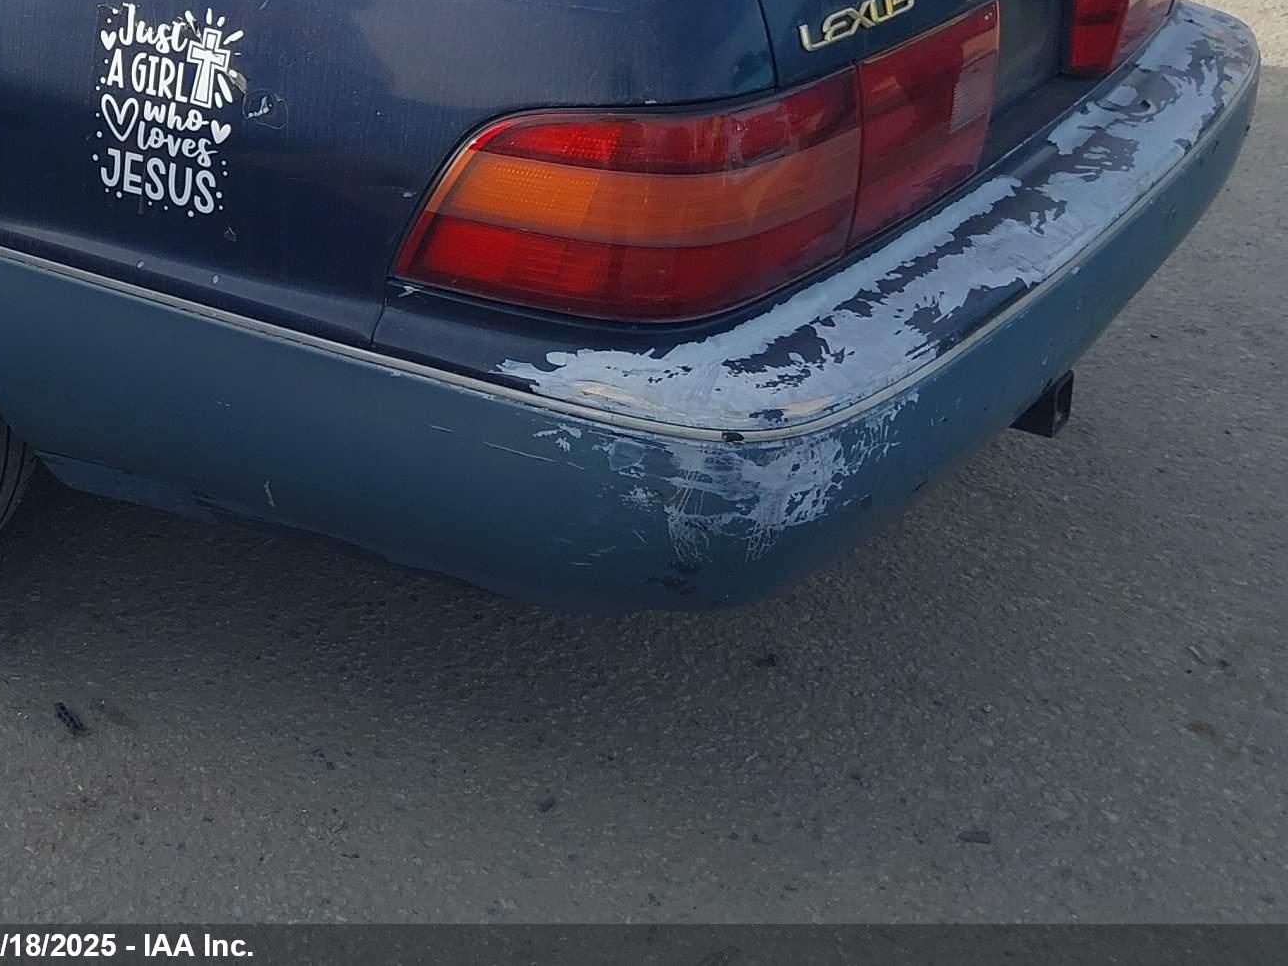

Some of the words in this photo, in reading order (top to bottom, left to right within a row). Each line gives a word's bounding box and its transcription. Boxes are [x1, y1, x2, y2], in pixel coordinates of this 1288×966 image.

[118, 1, 189, 54] Just
[106, 48, 124, 89] A
[131, 52, 188, 104] GIRL
[143, 100, 210, 132] who
[137, 120, 218, 168] loves
[100, 147, 217, 214] JESUS
